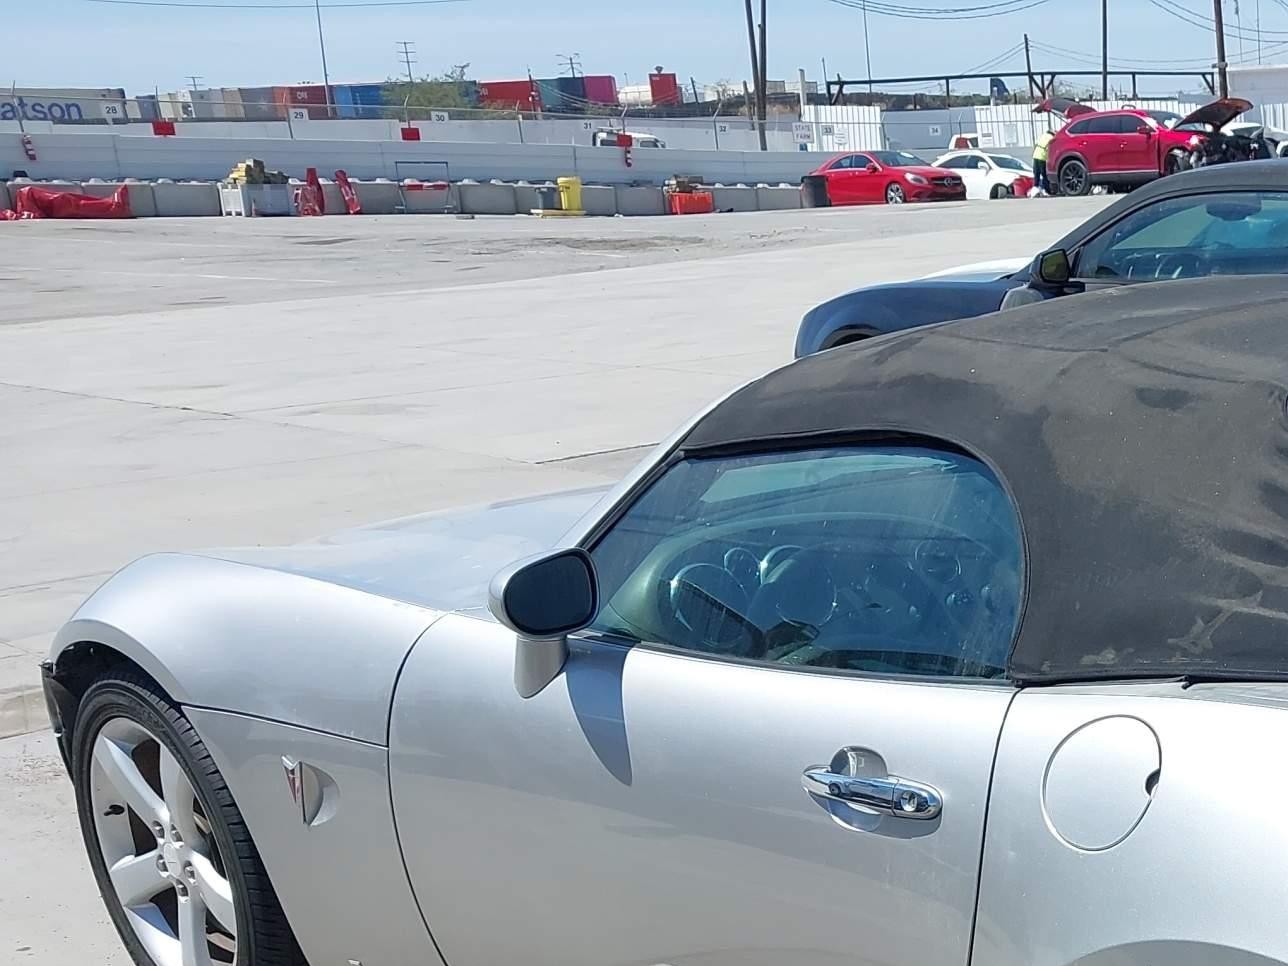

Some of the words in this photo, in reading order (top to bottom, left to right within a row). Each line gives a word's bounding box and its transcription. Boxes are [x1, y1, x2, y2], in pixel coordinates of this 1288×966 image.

[105, 105, 118, 114] 28
[294, 111, 304, 119] 29
[435, 114, 445, 122] 30
[583, 122, 593, 130] 31
